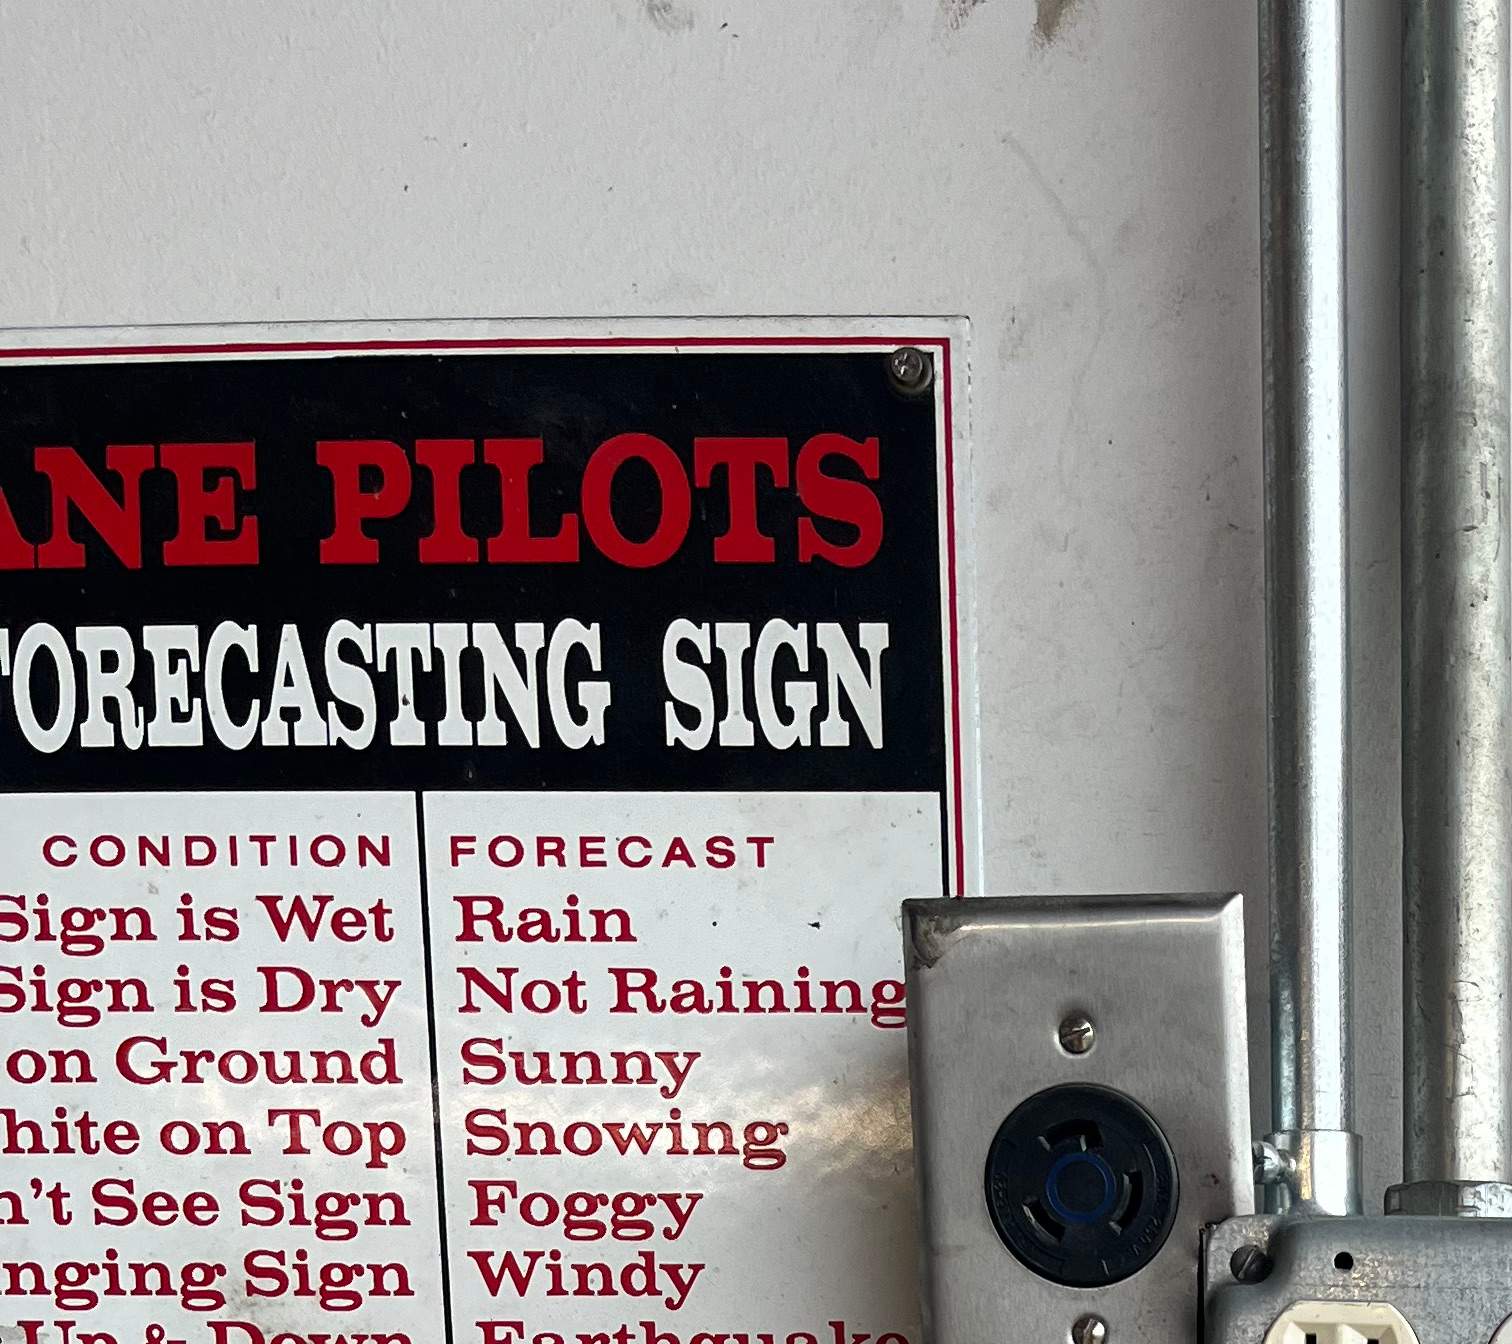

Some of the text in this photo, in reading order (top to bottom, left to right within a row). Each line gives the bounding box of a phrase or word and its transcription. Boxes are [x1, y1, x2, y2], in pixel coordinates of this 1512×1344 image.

[0, 432, 884, 570] NE PILOTS
[663, 617, 890, 751] SIGN
[42, 834, 391, 869] CONDITION
[451, 834, 774, 869] FORECAST
[0, 894, 394, 957] Sign is Wet
[454, 895, 636, 943] Rain
[0, 964, 401, 1028] Sign is Dry
[458, 965, 907, 1028] Not Raining
[6, 1036, 403, 1086] on Ground
[461, 1037, 701, 1099] Sunny
[159, 1120, 251, 1156] on
[268, 1108, 407, 1169] Top
[465, 1107, 789, 1171] Snowing
[91, 1178, 219, 1227] See
[240, 1178, 411, 1242] Sign
[469, 1179, 702, 1242] Foggy
[0, 1248, 415, 1312] nging Sign
[476, 1250, 704, 1312] Windy
